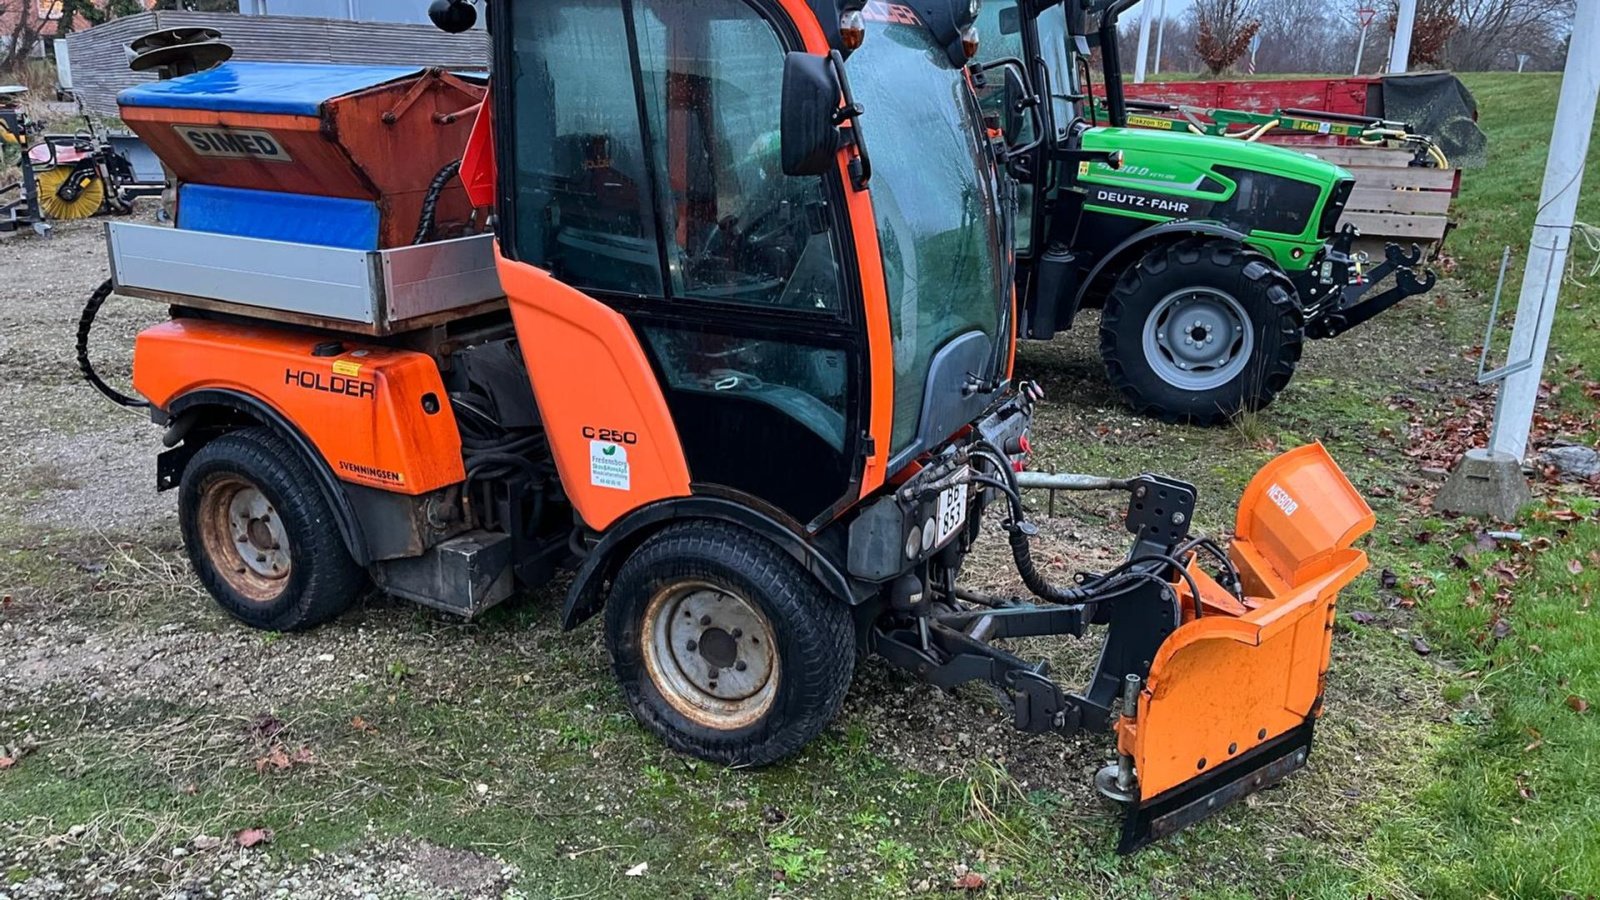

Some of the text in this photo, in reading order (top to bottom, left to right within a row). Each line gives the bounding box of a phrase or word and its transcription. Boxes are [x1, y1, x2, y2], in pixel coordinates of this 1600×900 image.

[187, 131, 279, 156] SIMED
[1097, 190, 1189, 213] DEUTZ-FAHR
[285, 368, 375, 400] HOLDER
[582, 426, 637, 444] C 250
[339, 460, 400, 481] SVENNINGSEN
[943, 501, 961, 536] 853
